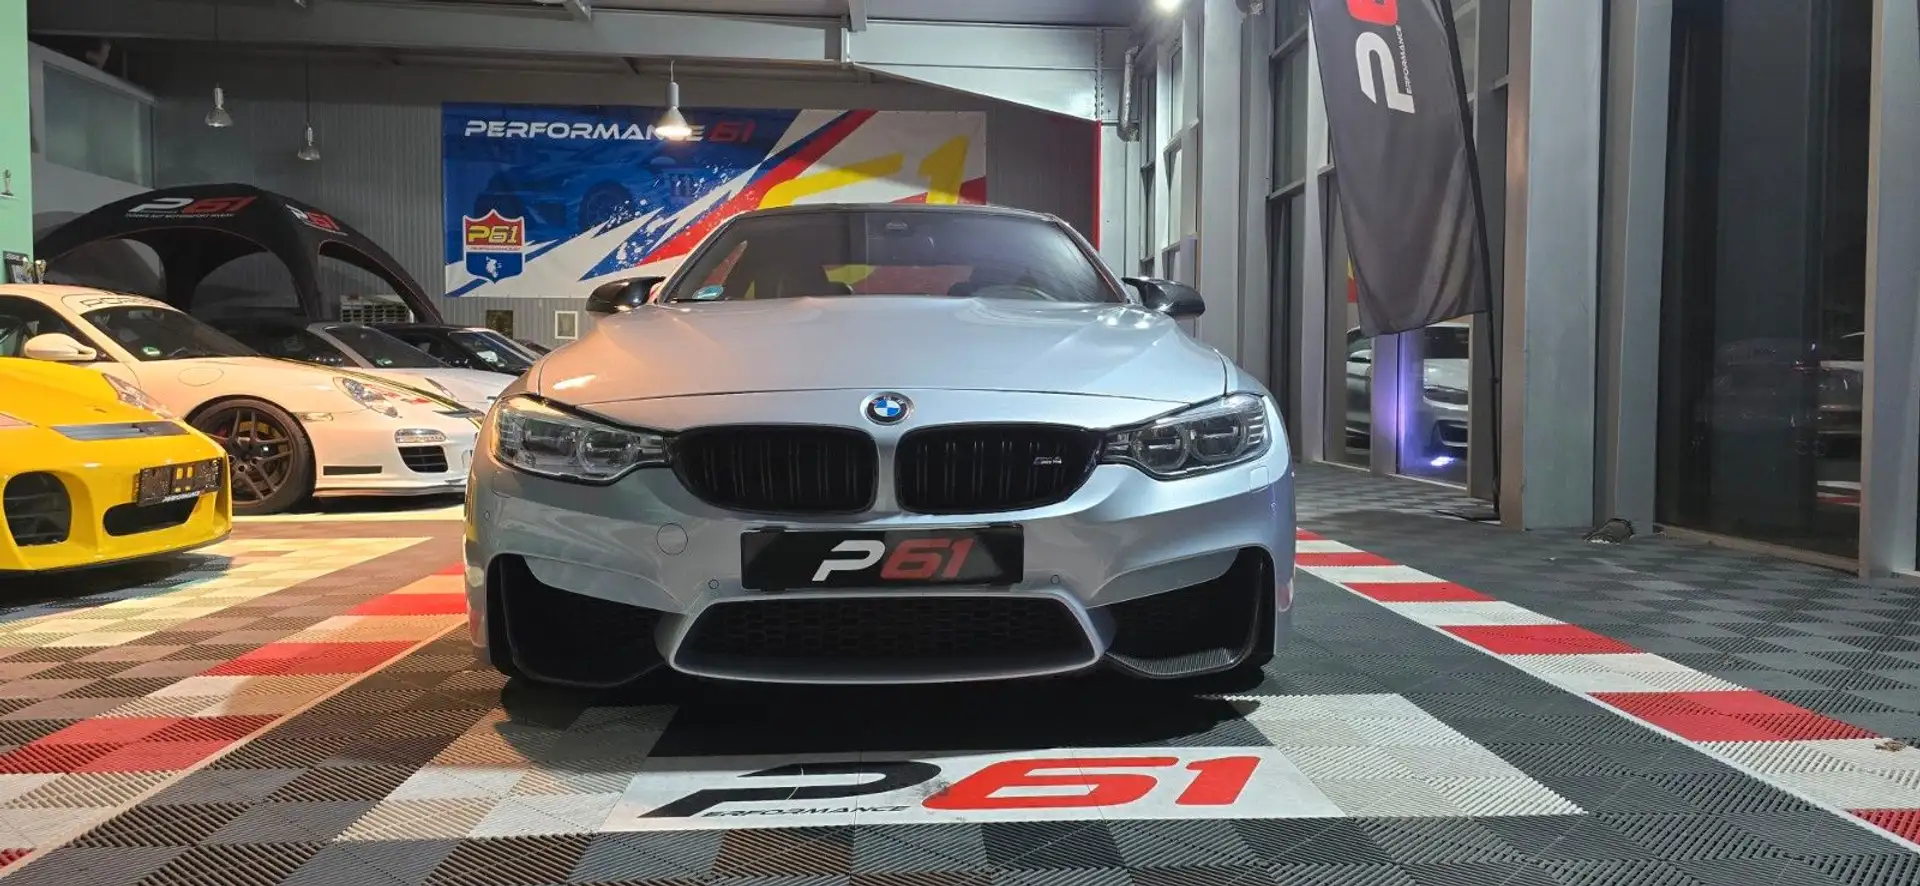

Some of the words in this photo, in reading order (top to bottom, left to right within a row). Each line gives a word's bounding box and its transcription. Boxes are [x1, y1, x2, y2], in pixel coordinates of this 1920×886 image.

[464, 119, 706, 142] PERFORMANE
[708, 120, 758, 143] 61
[467, 225, 519, 244] P61
[811, 538, 975, 583] P61
[638, 755, 1262, 819] P61
